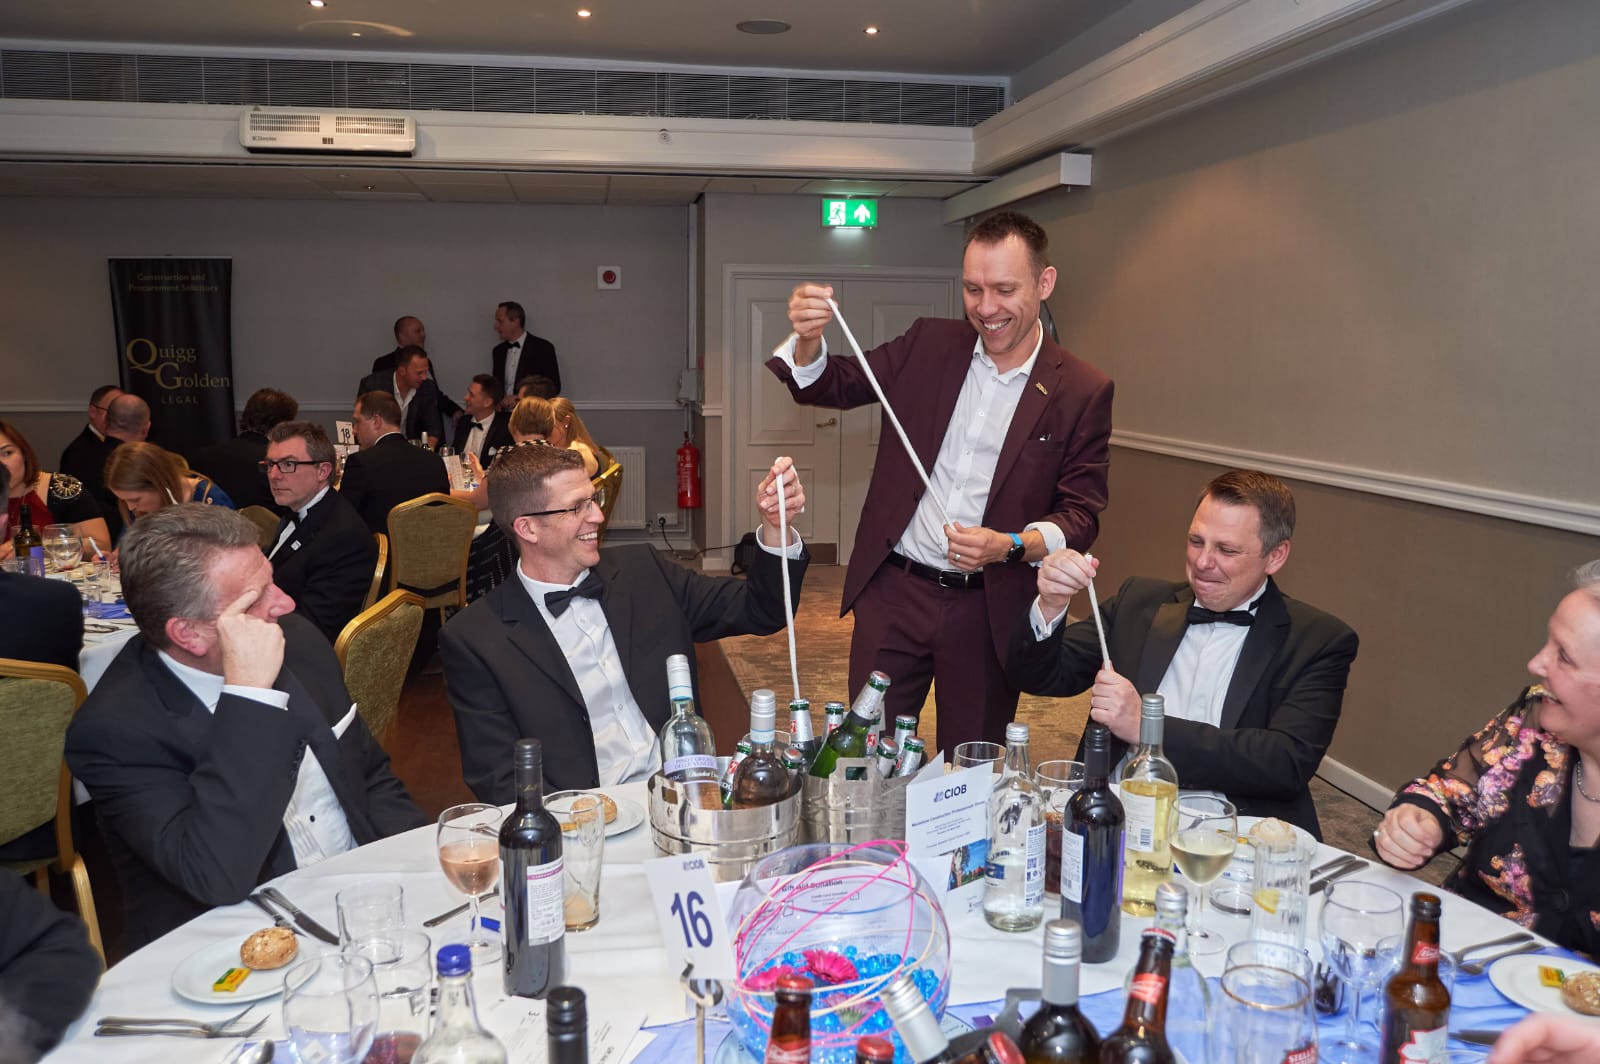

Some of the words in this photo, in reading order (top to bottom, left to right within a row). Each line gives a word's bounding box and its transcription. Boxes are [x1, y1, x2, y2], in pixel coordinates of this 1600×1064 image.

[137, 273, 188, 281] Construction
[191, 273, 206, 281] and
[128, 283, 179, 292] Procurement
[181, 283, 219, 292] Solicitors
[126, 338, 197, 374] Quigg
[156, 362, 230, 390] Golden
[161, 395, 199, 404] LEGAL
[340, 427, 351, 439] 18
[944, 784, 967, 799] CIOB
[671, 891, 713, 948] 16
